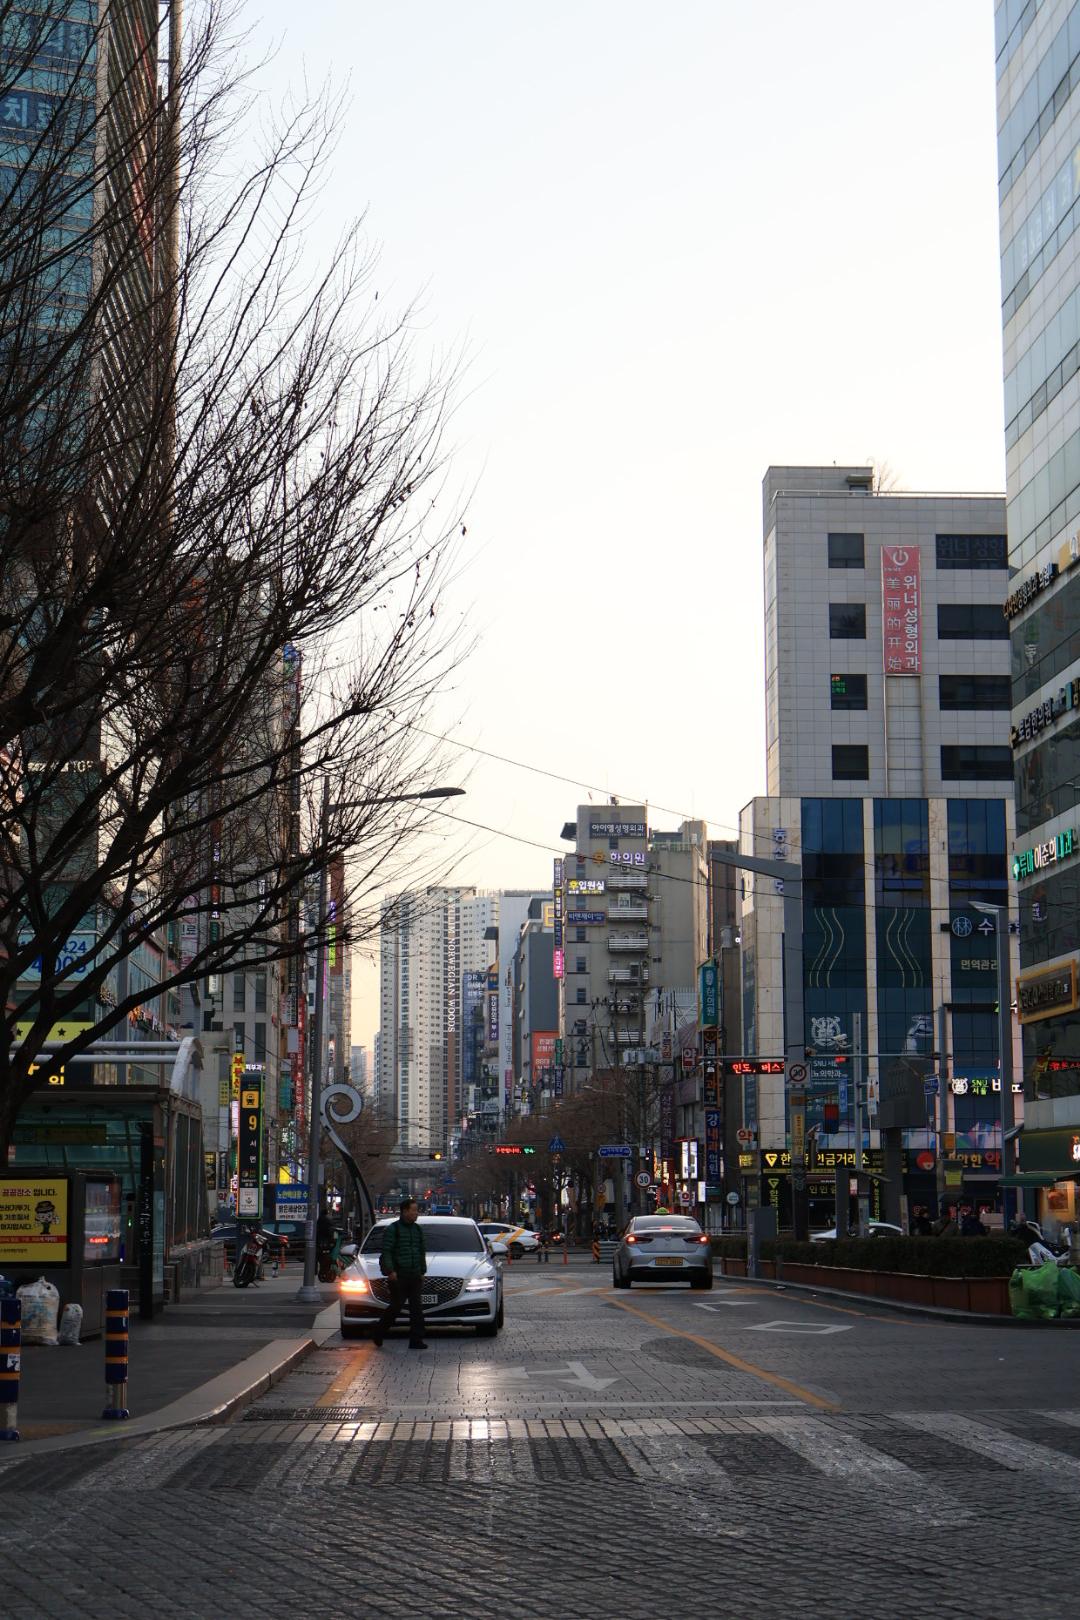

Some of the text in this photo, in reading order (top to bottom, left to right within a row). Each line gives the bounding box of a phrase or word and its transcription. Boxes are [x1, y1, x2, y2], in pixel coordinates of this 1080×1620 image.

[903, 575, 919, 671] 위너성형외과
[610, 852, 645, 865] 한의원
[578, 881, 604, 890] 입원실
[447, 1000, 456, 1033] WOODS
[248, 1115, 258, 1131] 9
[639, 1175, 649, 1183] 30
